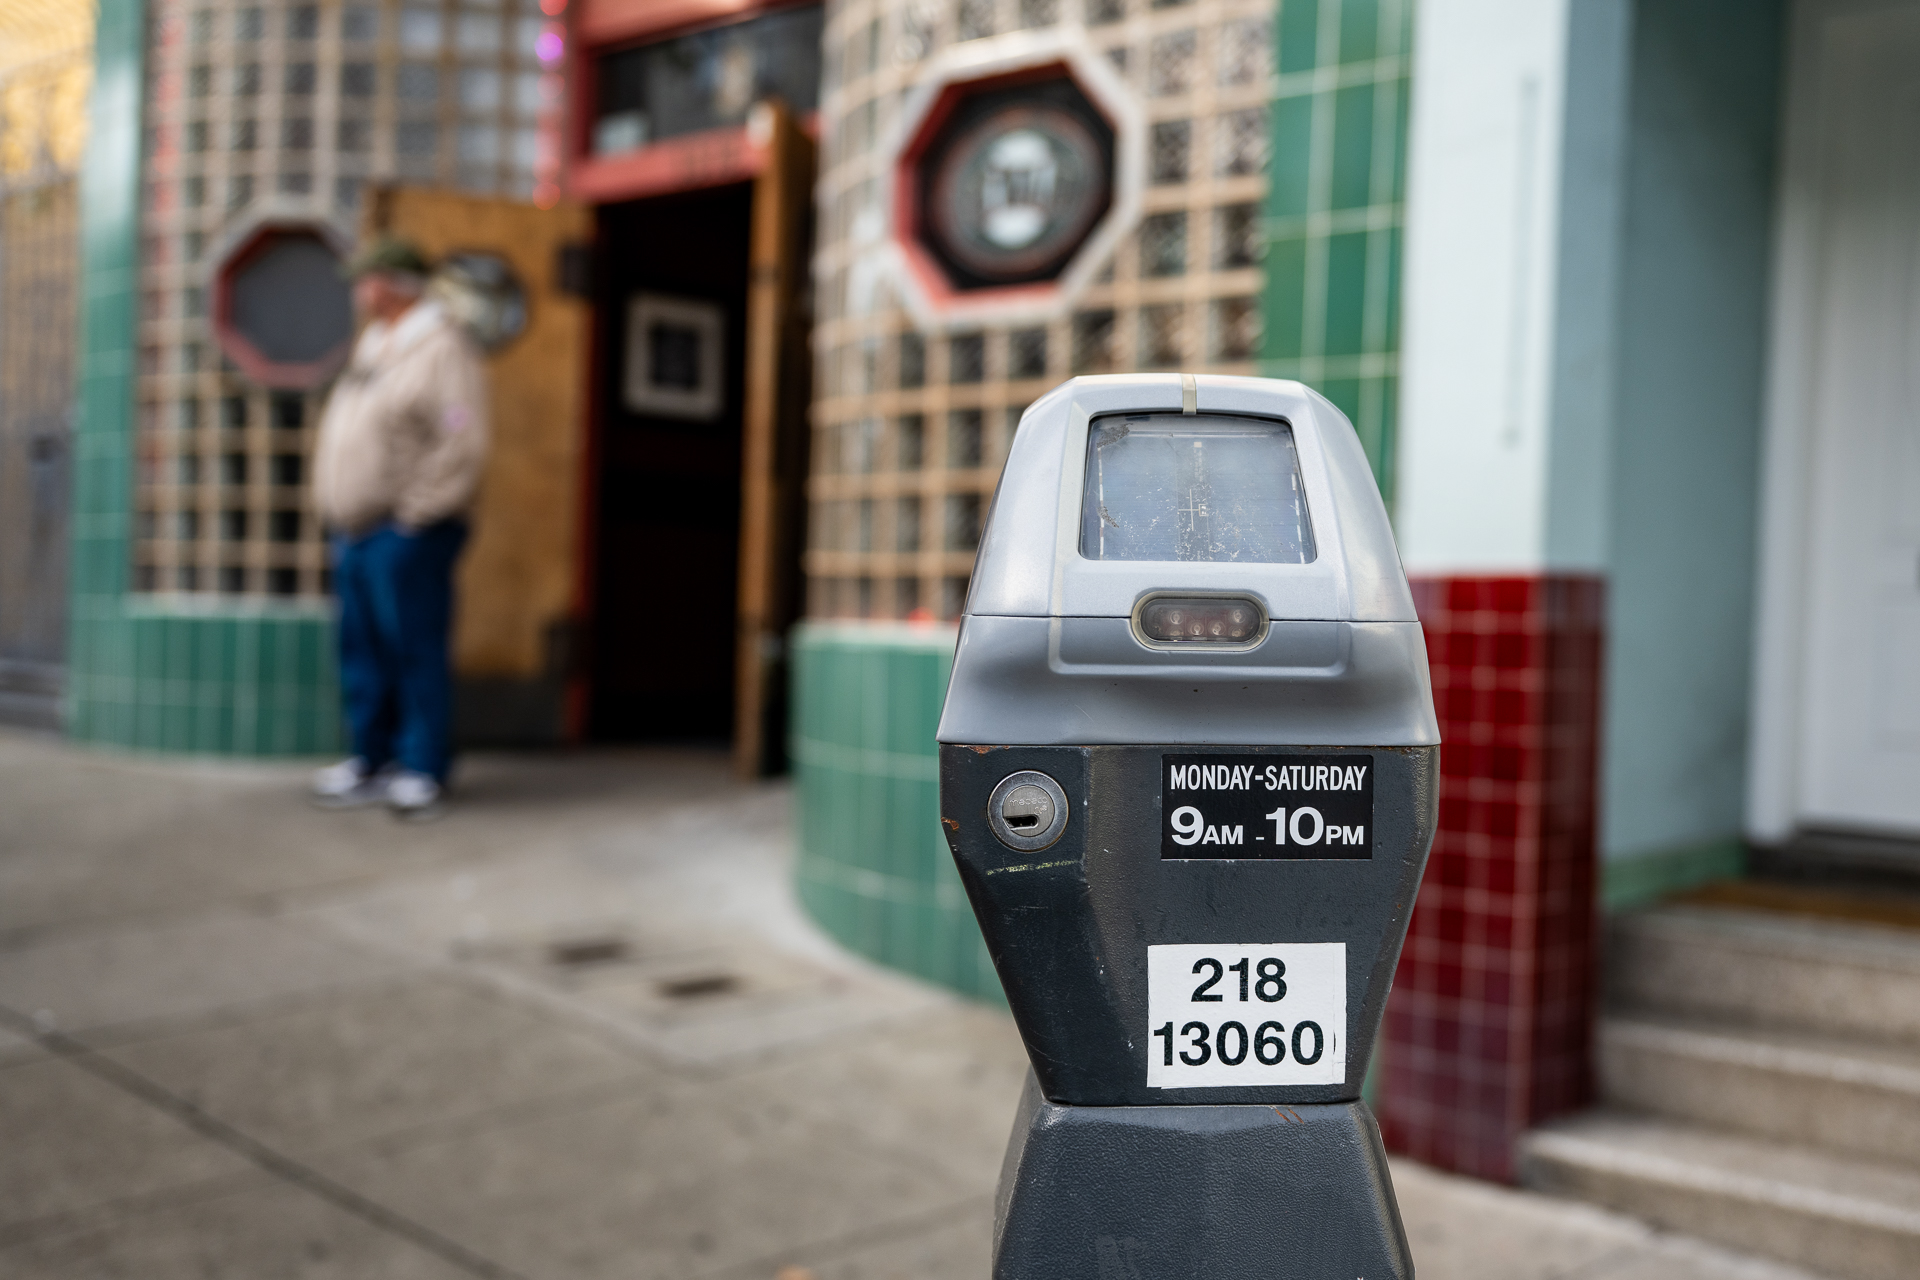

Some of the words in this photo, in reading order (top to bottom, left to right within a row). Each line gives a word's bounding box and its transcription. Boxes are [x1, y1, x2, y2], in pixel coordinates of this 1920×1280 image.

[1170, 764, 1366, 791] MONDAY-SATURDAY
[1170, 805, 1244, 846] 9AM
[1190, 957, 1288, 1003] 218
[1153, 1020, 1324, 1067] 13060
